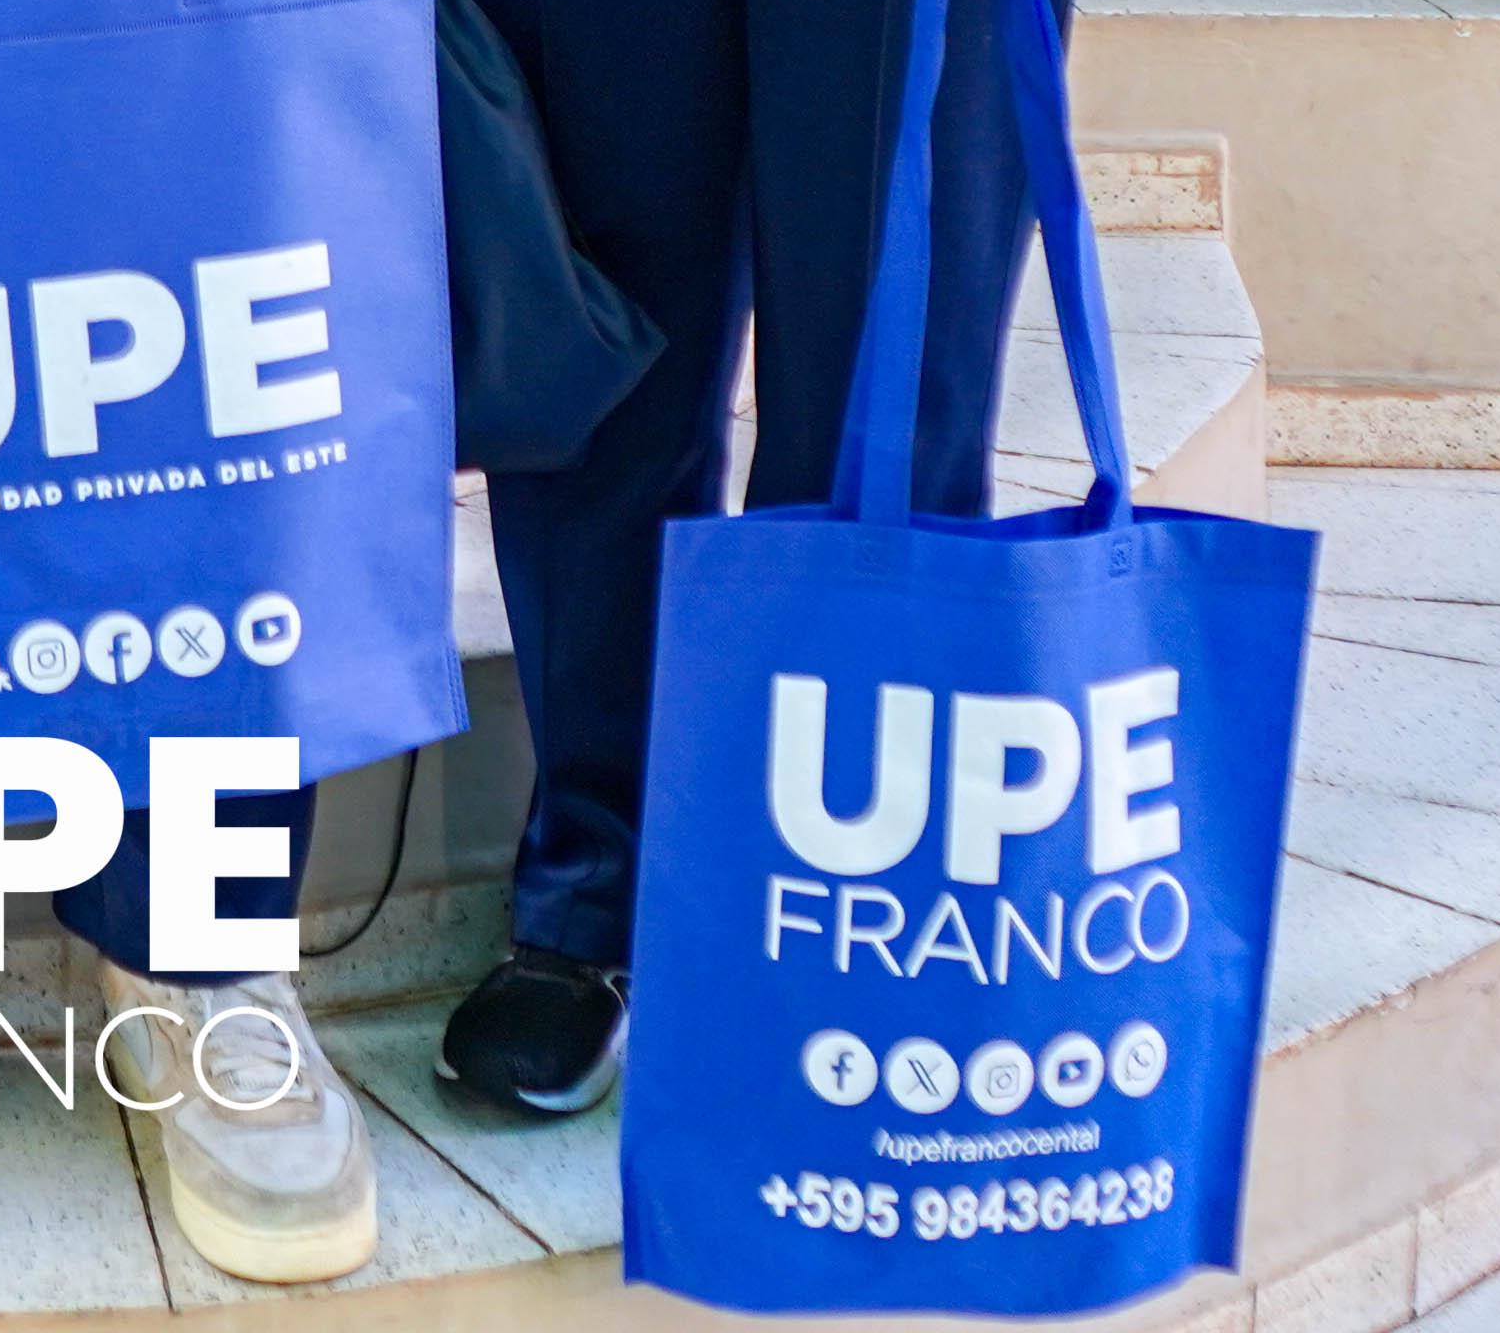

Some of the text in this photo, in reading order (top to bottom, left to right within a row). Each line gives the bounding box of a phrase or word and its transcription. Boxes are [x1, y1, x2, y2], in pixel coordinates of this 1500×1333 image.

[74, 464, 206, 502] PRIVADA
[219, 456, 273, 484] DEL
[286, 440, 347, 474] ESTE
[769, 666, 1181, 885] UPE
[764, 866, 1190, 986] FRANCO
[760, 1156, 1175, 1241] +595 984364238
